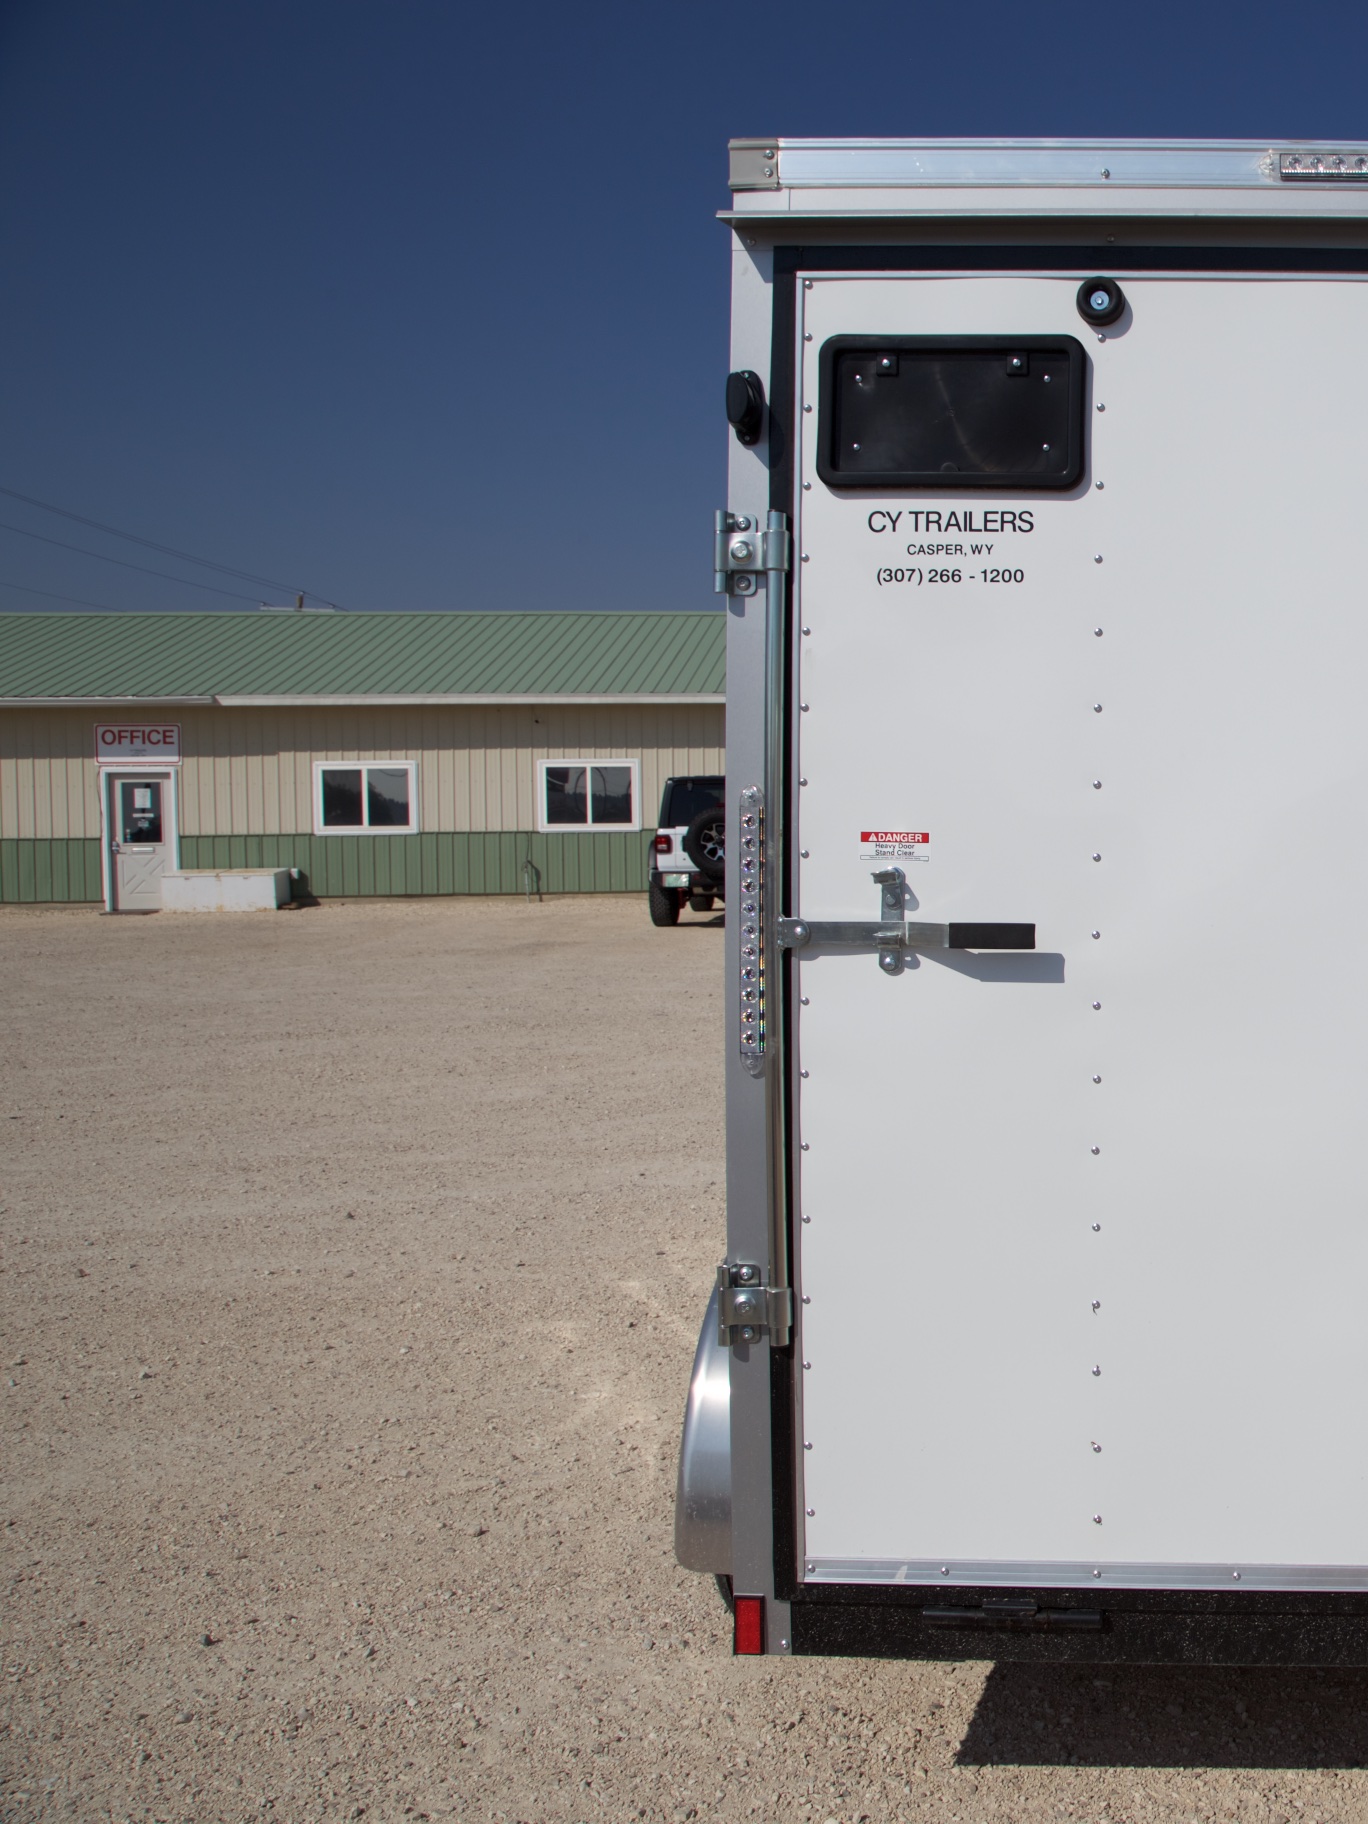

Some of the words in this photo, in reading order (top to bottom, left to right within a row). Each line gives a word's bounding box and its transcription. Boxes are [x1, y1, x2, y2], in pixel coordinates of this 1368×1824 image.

[868, 511, 902, 533] CY
[908, 511, 1034, 533] TRAILERS
[907, 544, 967, 557] CASPER,
[970, 544, 994, 555] WY
[876, 568, 923, 586] (307)
[928, 569, 962, 583] 266
[980, 569, 1024, 583] 1200
[101, 729, 175, 746] OFFICE
[878, 833, 922, 842] DANGER
